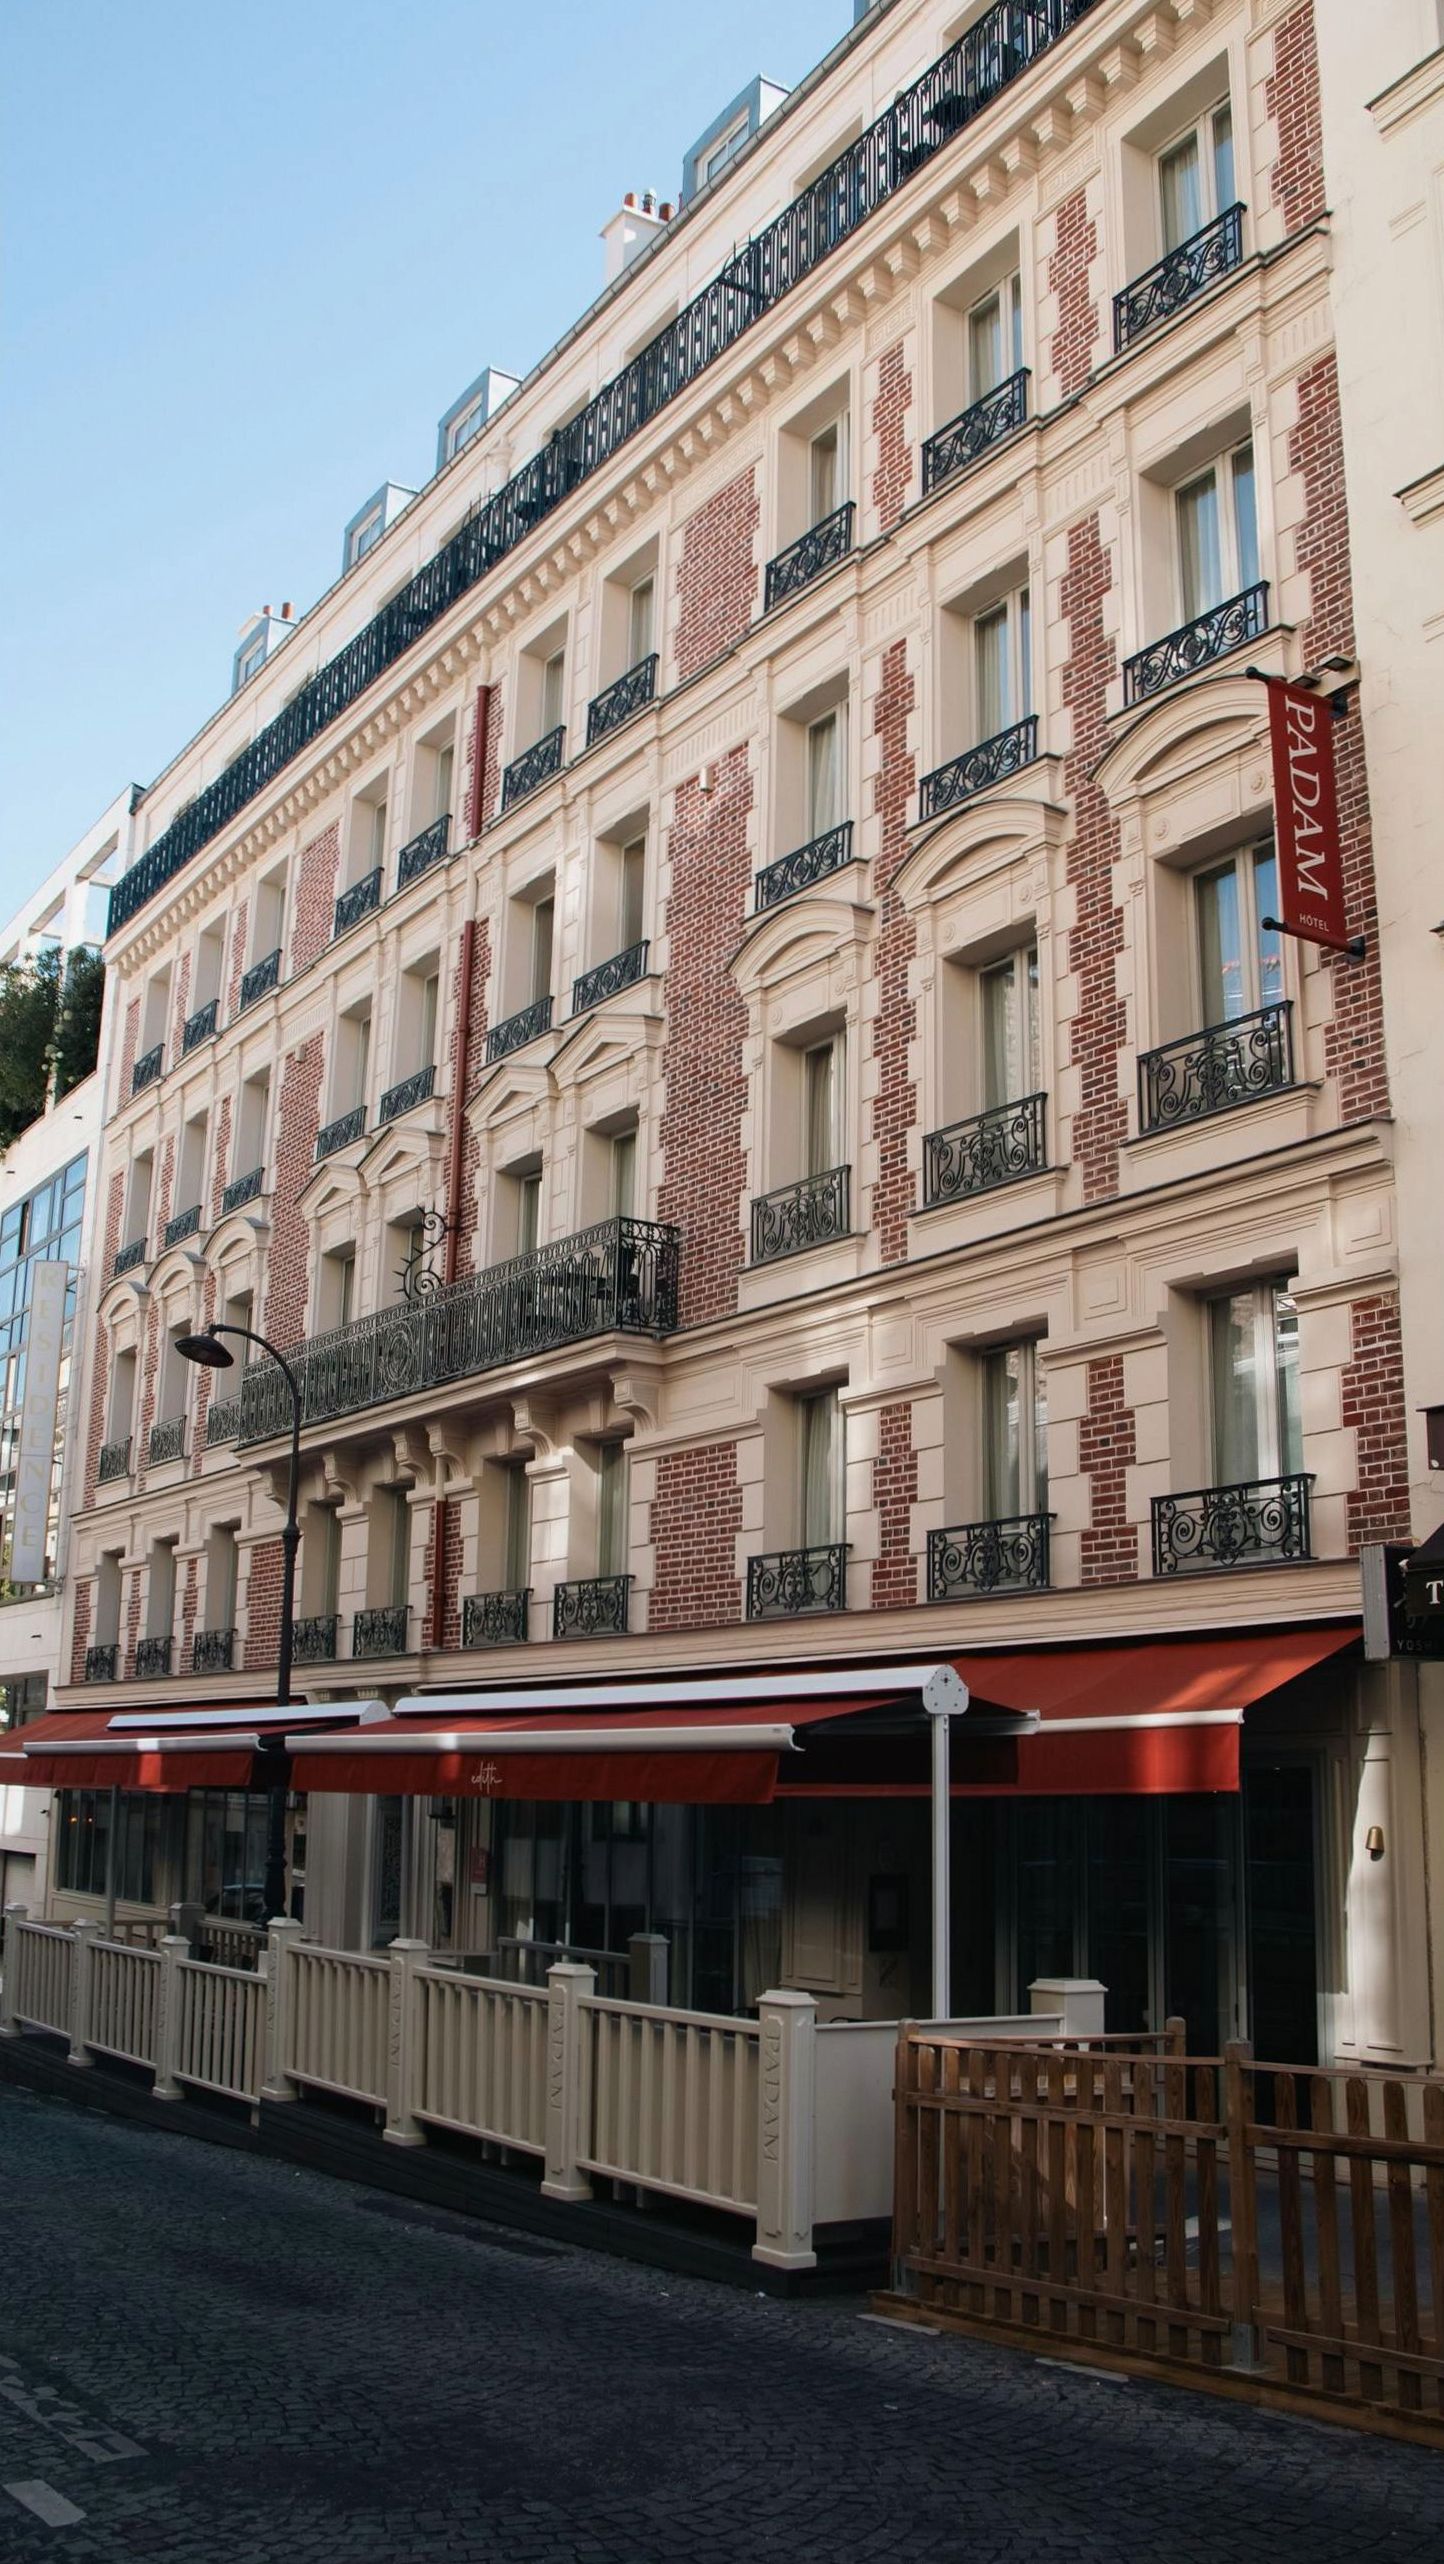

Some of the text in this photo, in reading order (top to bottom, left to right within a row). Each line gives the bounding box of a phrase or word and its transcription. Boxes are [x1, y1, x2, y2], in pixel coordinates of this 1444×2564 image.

[1285, 695, 1328, 900] PADAM
[20, 1270, 59, 1547] RESIDENCE
[471, 1761, 503, 1795] edith
[763, 2031, 780, 2162] PADAM
